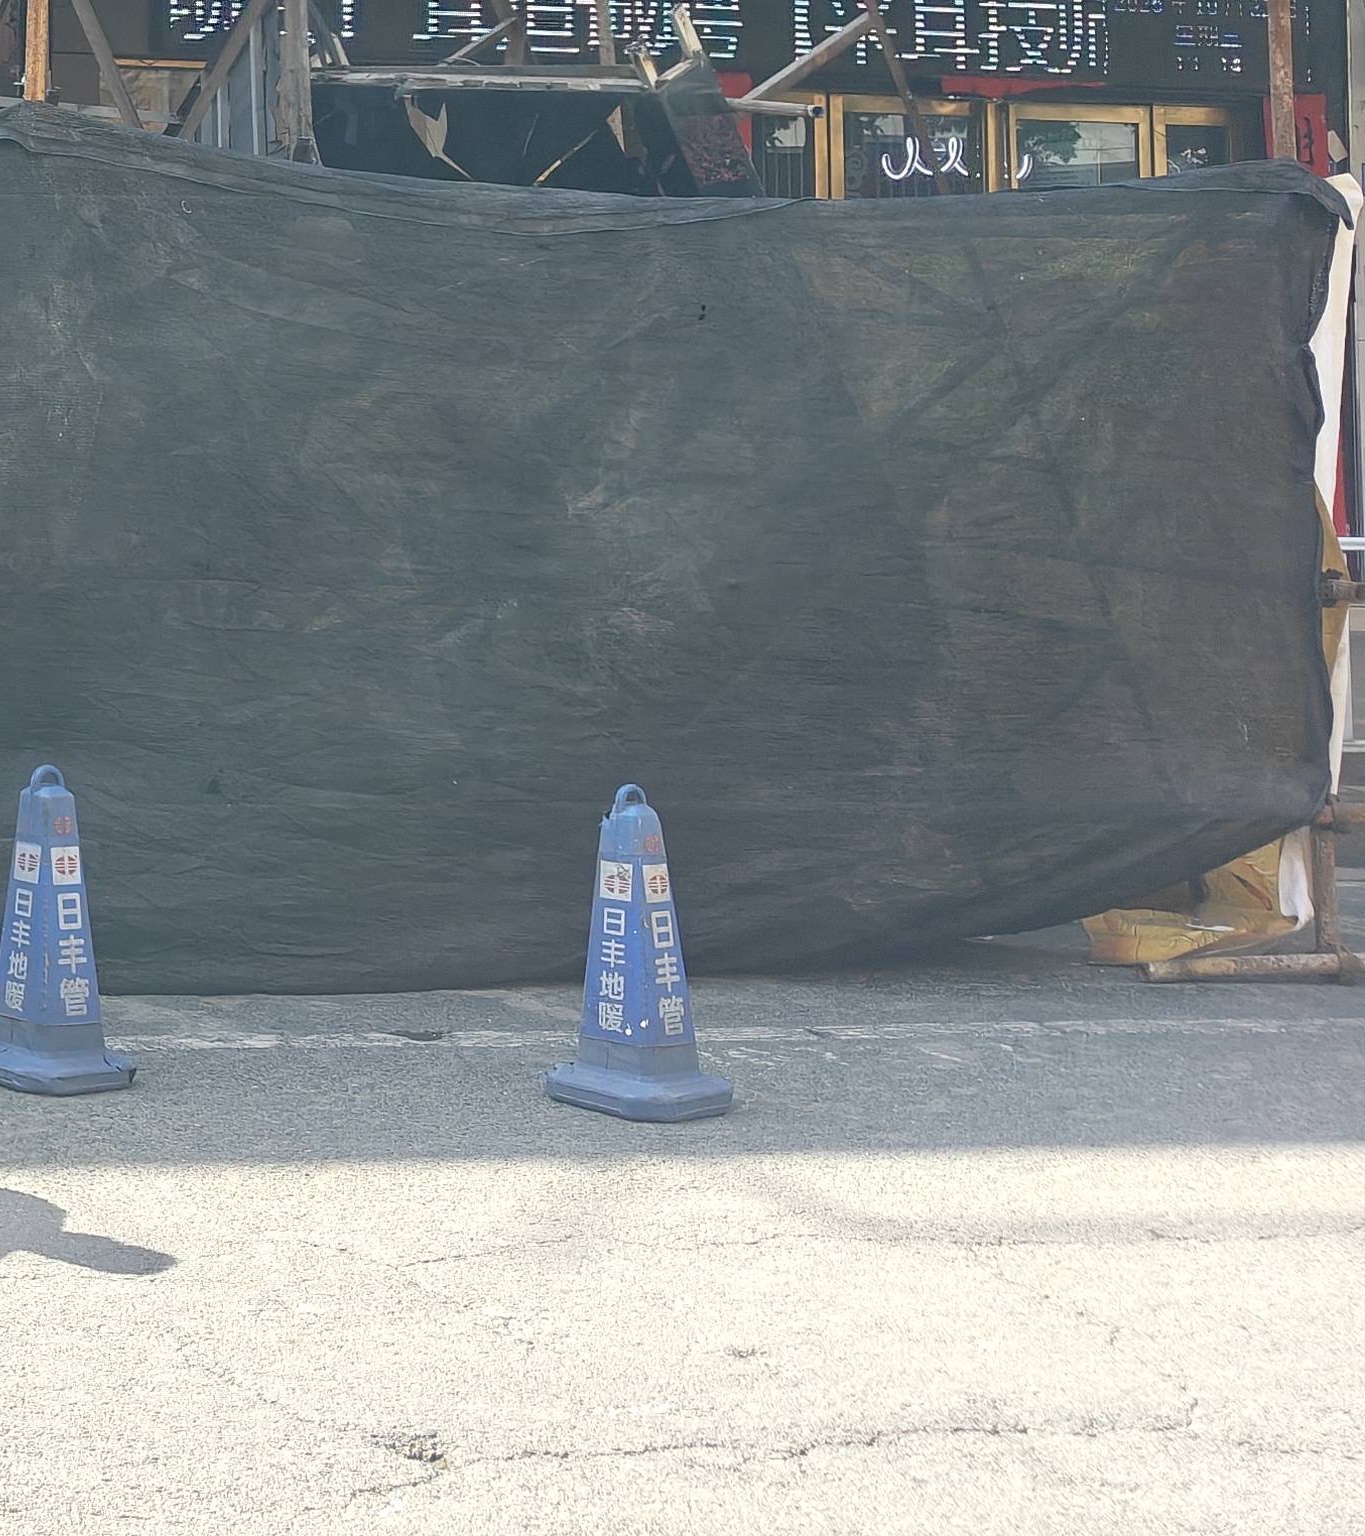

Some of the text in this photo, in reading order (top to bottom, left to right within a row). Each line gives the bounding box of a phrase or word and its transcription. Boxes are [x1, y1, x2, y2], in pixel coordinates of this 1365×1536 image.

[598, 907, 626, 1035] 日丰地暖
[649, 909, 685, 1037] 日丰管
